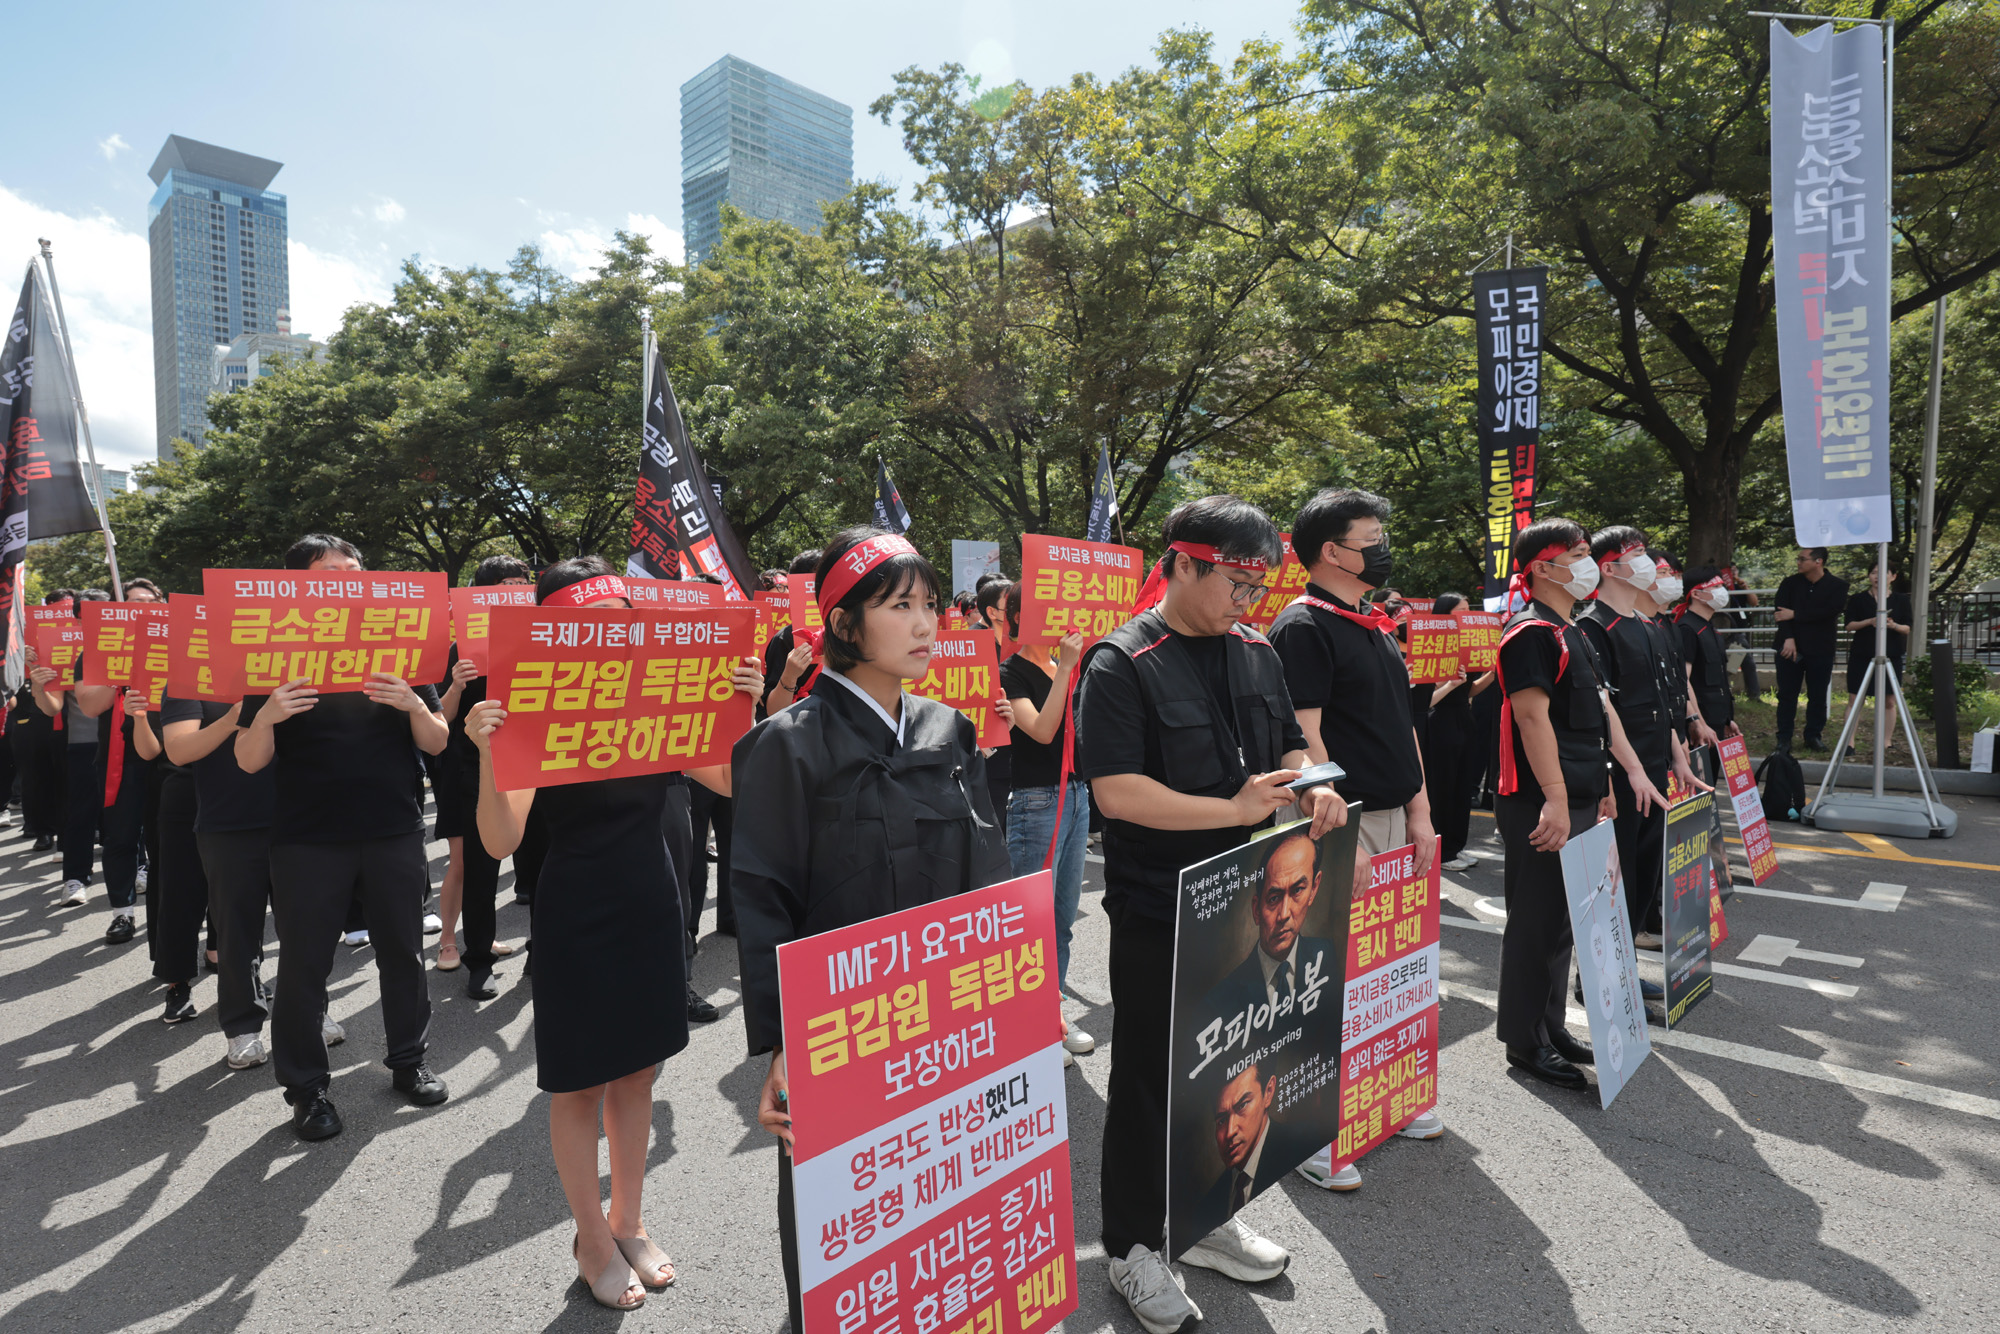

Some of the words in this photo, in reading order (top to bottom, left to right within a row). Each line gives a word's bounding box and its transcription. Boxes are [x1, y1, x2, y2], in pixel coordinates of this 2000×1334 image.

[1489, 287, 1514, 434] 모피아의
[1513, 285, 1539, 430] 국민경제
[1048, 544, 1091, 565] 관치금융
[1093, 550, 1131, 569] 막아내고
[235, 580, 297, 598] 모피아
[305, 581, 364, 599] 자리만
[371, 581, 425, 599] 늘리는
[663, 587, 710, 605] 부합하는
[1034, 568, 1138, 605] 금융소비자
[230, 608, 350, 645] 금소원
[360, 608, 431, 641] 분리
[531, 622, 645, 647] 국제기준에
[653, 622, 731, 646] 부합하는
[1411, 634, 1445, 655] 금소원
[1460, 628, 1490, 647] 금감원
[245, 648, 422, 687] 반대한다!
[507, 660, 634, 713] 금감원
[641, 656, 741, 705] 독립성
[901, 665, 991, 702] 소비자
[1412, 658, 1437, 679] 결사
[540, 712, 717, 772] 보장하라!
[1668, 830, 1709, 876] 금융소비자
[1192, 886, 1223, 910] 성공하면
[1225, 879, 1241, 894] 자리
[1350, 889, 1395, 935] 금소원
[1402, 877, 1428, 915] 분리
[1673, 871, 1688, 900] 경보
[827, 931, 911, 995] IMF가
[921, 901, 1025, 963] 요구하는
[1356, 927, 1388, 968] 결사
[1394, 913, 1422, 951] 반대
[807, 979, 931, 1077] 금감원
[949, 938, 1047, 1013] 독립성
[1341, 999, 1393, 1043] 금융소비자
[1395, 978, 1433, 1016] 지켜내자
[1348, 955, 1428, 1011] 관치금융으로부터
[1189, 989, 1296, 1080] 모피아의
[1298, 950, 1329, 1016] 봄
[1270, 1027, 1303, 1053] spring
[884, 1017, 997, 1101] 보장하라
[1347, 1046, 1371, 1080] 실익
[1373, 1037, 1396, 1067] 없는
[1396, 1016, 1427, 1052] 쪼개기
[1343, 1047, 1429, 1121] 금융소비자는
[850, 1120, 931, 1192] 영국도
[939, 1072, 1030, 1146] 반성했다
[1337, 1104, 1383, 1159] 피눈물
[1389, 1073, 1434, 1127] 흘린다!
[819, 1183, 905, 1262] 쌍봉형
[913, 1152, 963, 1209] 체계
[970, 1103, 1056, 1178] 반대한다
[835, 1261, 899, 1334] 임원
[910, 1213, 992, 1290] 자리는
[1000, 1167, 1053, 1232] 증가!
[913, 1256, 995, 1334] 효율은
[1003, 1213, 1056, 1280] 감소!
[1016, 1252, 1067, 1331] 반대
